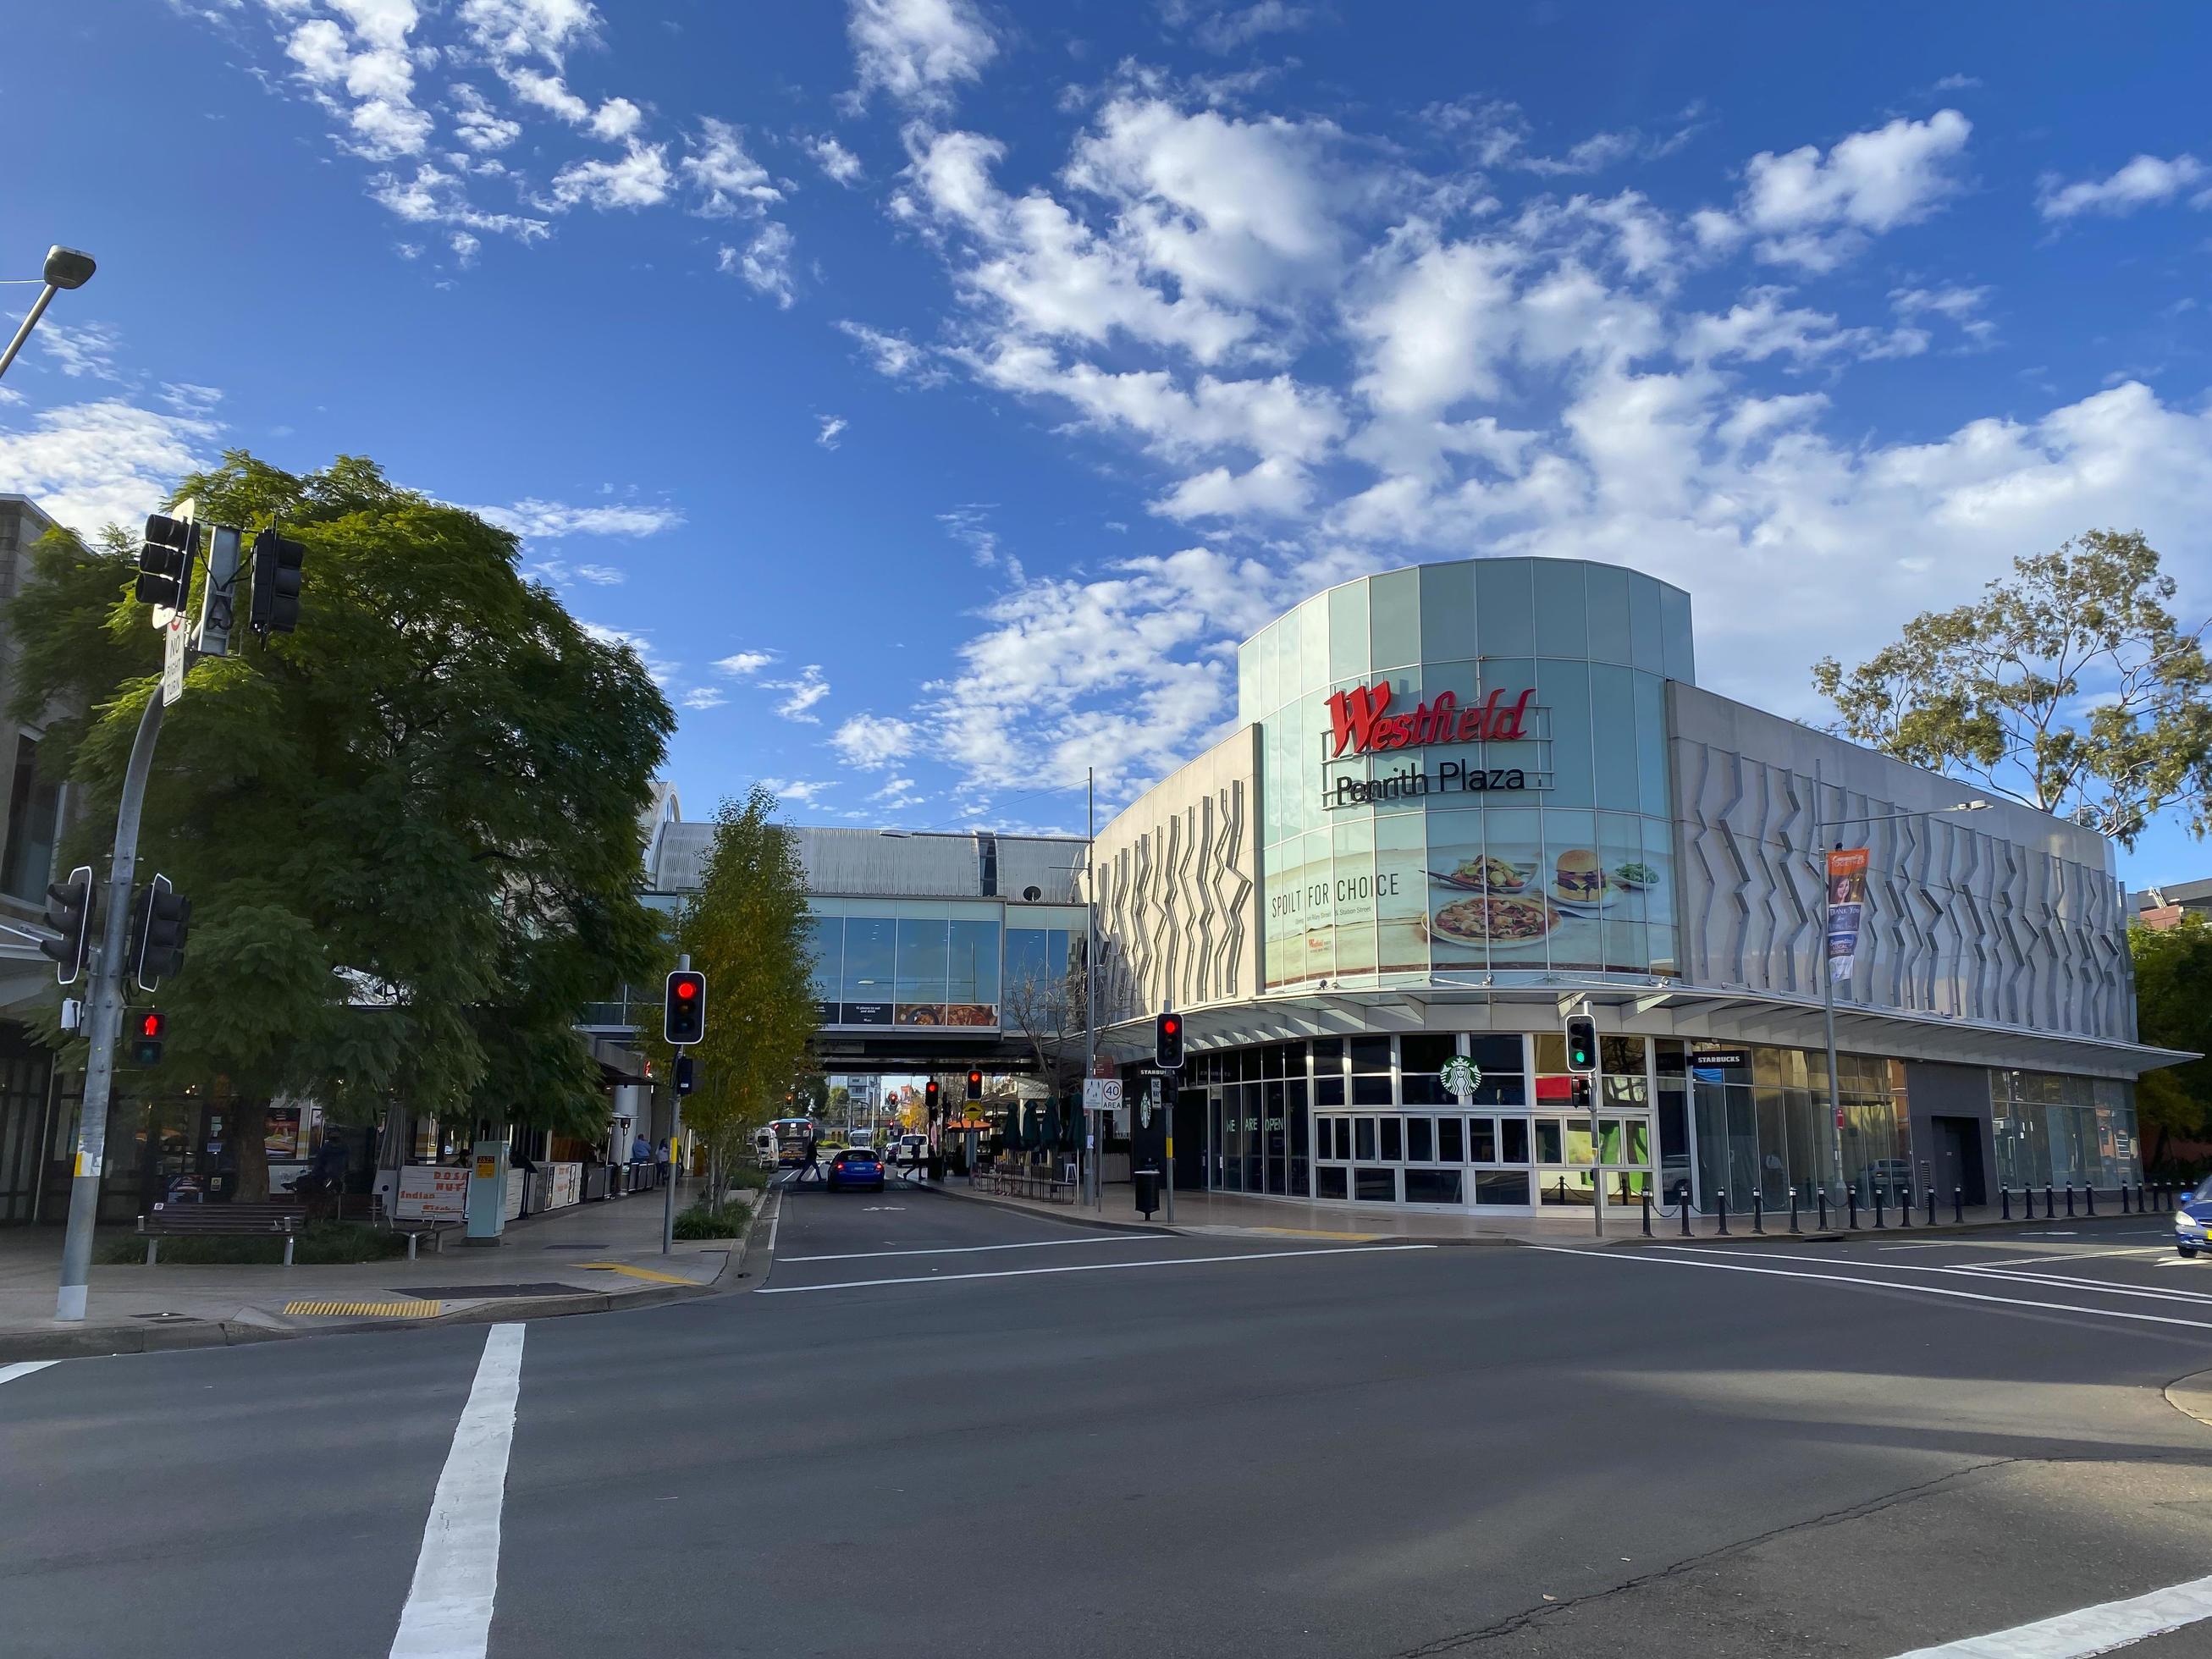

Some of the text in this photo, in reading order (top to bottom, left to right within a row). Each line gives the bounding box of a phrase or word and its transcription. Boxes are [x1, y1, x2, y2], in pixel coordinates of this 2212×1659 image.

[170, 635, 180, 658] NO
[167, 677, 179, 697] TURN
[1324, 681, 1536, 758] Westfield
[1336, 758, 1525, 805] Penrith Plaza
[1272, 874, 1399, 918] SPOILT FOR CHOICE
[1106, 1086, 1119, 1096] 40
[1227, 1117, 1284, 1133] WE ARE OPEN
